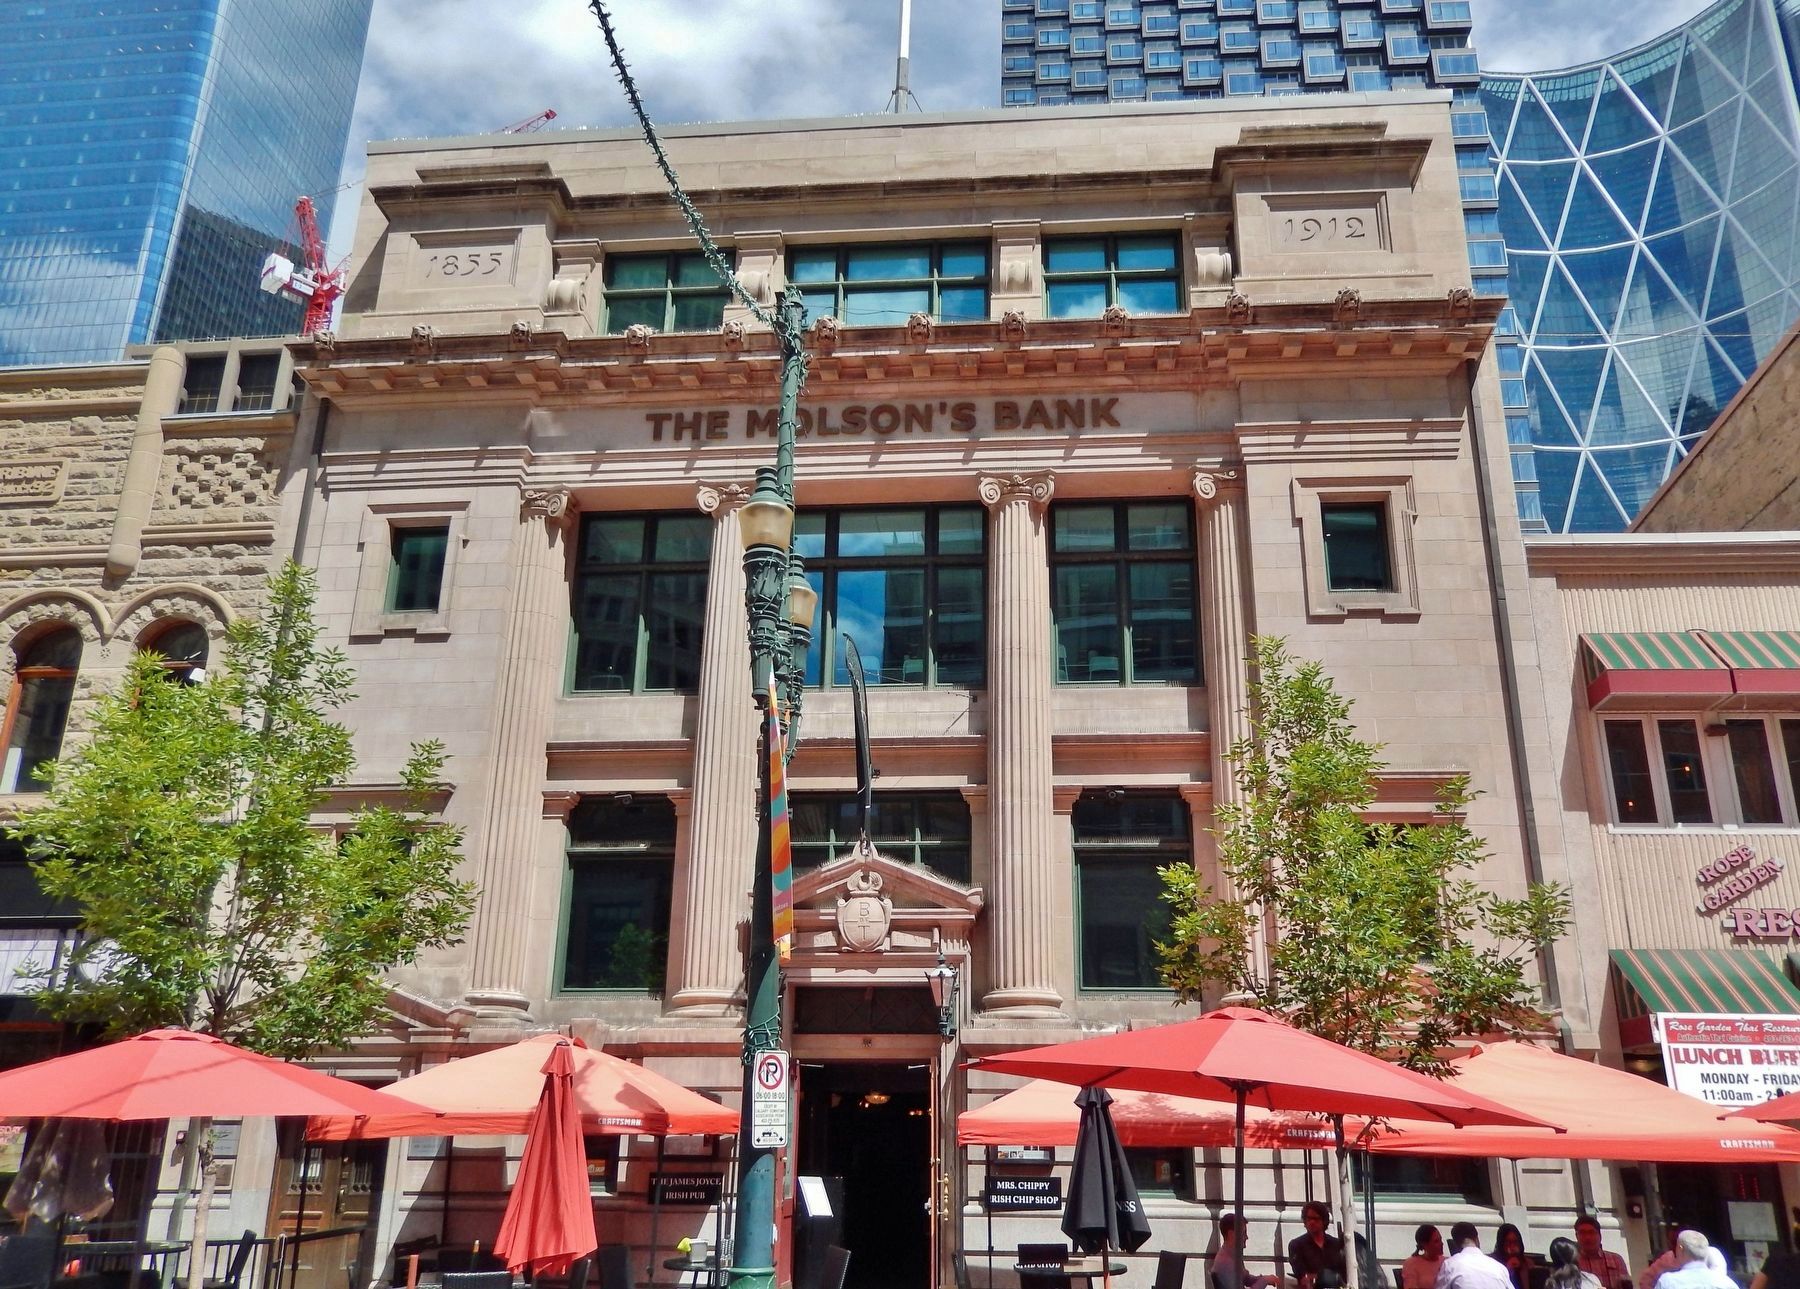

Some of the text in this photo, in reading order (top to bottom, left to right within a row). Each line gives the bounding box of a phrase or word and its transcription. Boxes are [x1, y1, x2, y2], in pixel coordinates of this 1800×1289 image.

[1284, 216, 1366, 242] 1912
[424, 252, 503, 279] 1855
[645, 410, 731, 441] THE
[993, 398, 1121, 430] BANK
[1699, 845, 1755, 882] ROSE
[1703, 856, 1784, 910] GARDEN
[1668, 1021, 1693, 1031] Rose
[1696, 1021, 1732, 1033] Garden
[1735, 1021, 1759, 1032] Thai
[1672, 1047, 1800, 1066] LUNCH BUFF
[1700, 1072, 1750, 1084] MONDAY
[1701, 1089, 1754, 1101] 11:00am
[598, 1117, 642, 1126] CRAFTSMAN
[1287, 1128, 1337, 1139] CRAFTSMAN
[1719, 1139, 1776, 1149] CRAFTSMAN
[669, 1177, 696, 1187] JAMES
[695, 1177, 722, 1187] JOYCE
[996, 1181, 1050, 1190] MRS. CHIPPY
[665, 1191, 706, 1200] IRISH PUB
[1012, 1195, 1035, 1204] CHIP
[1035, 1195, 1059, 1205] SHOP
